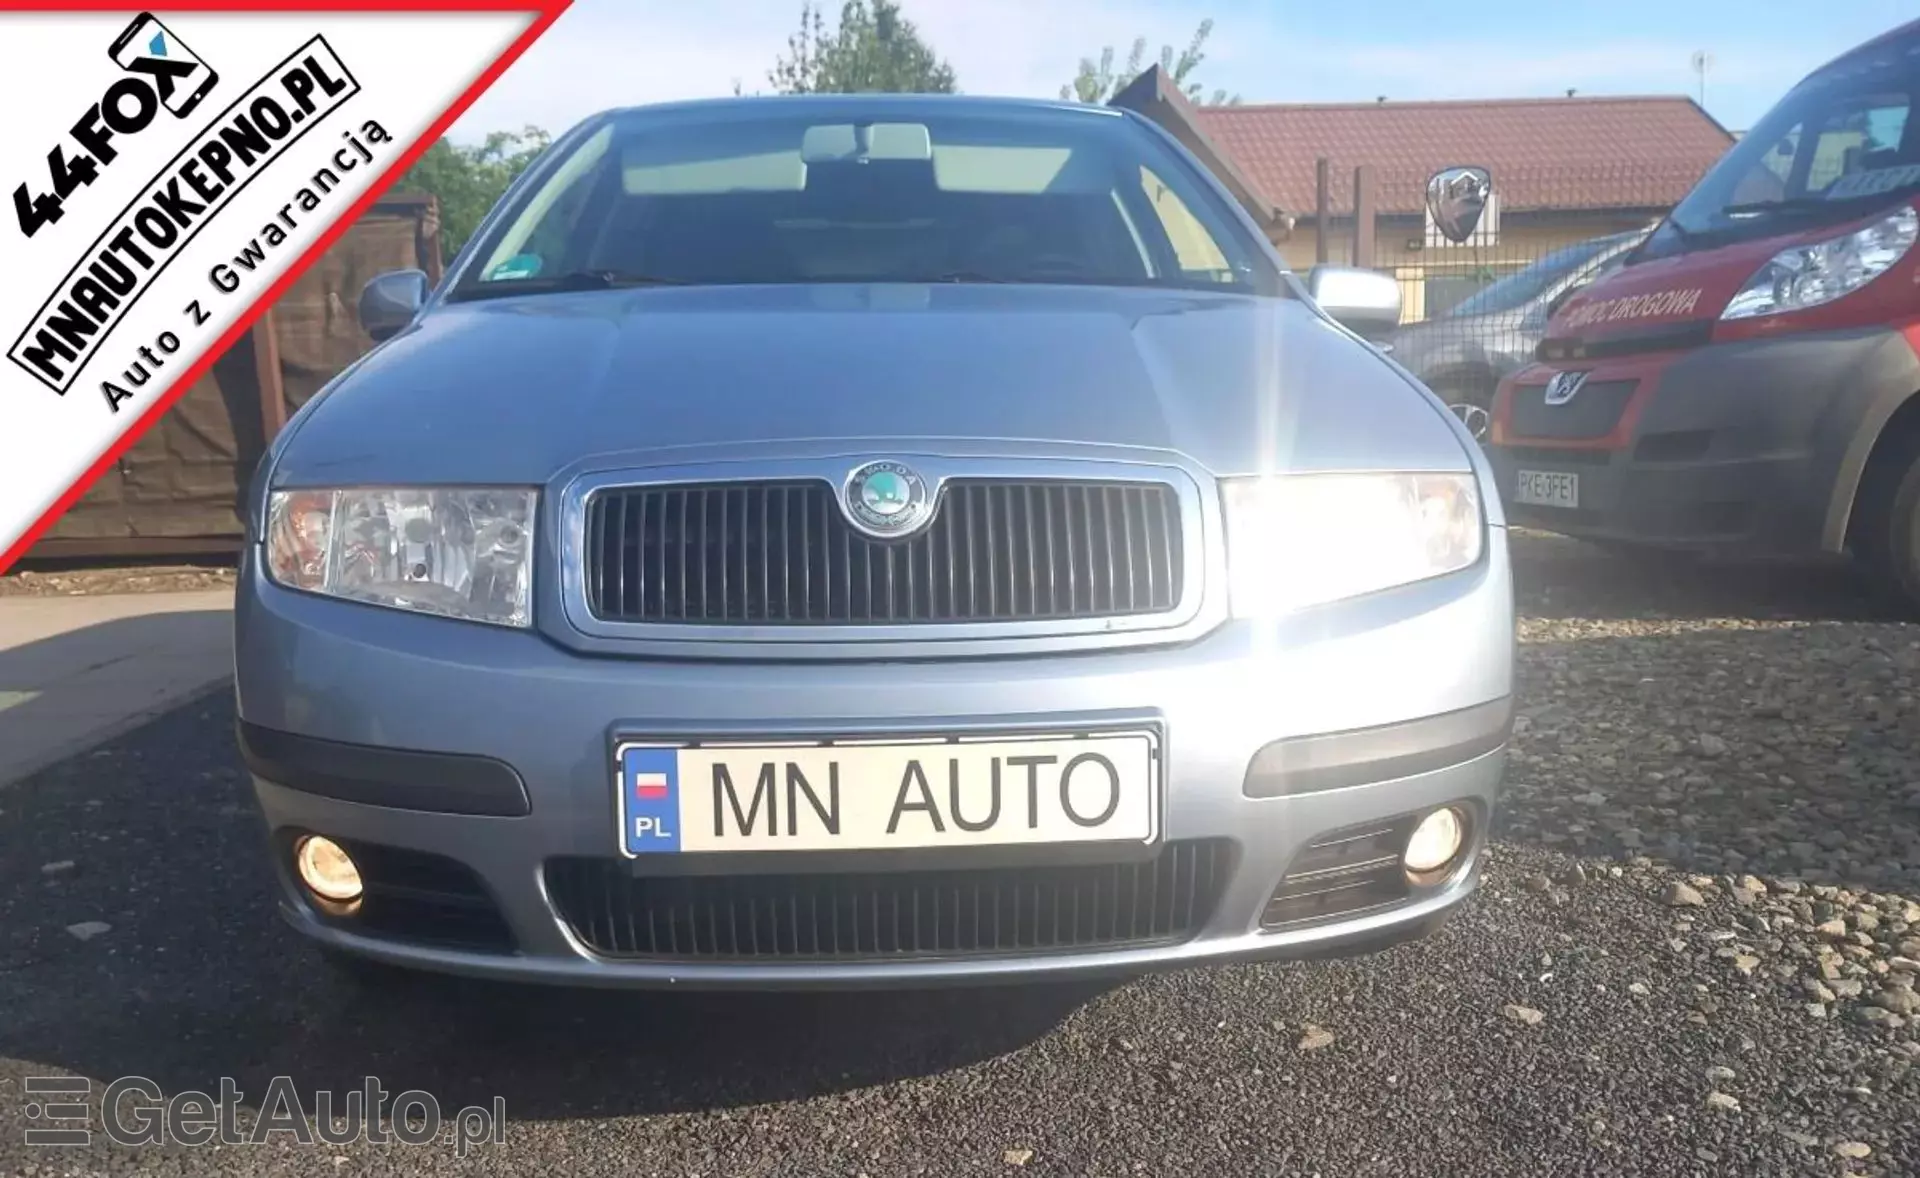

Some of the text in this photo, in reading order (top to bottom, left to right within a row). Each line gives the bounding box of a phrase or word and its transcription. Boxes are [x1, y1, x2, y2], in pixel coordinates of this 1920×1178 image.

[1607, 288, 1702, 322] DROGOWA
[712, 752, 1121, 837] MN AUTO
[635, 816, 672, 838] PL
